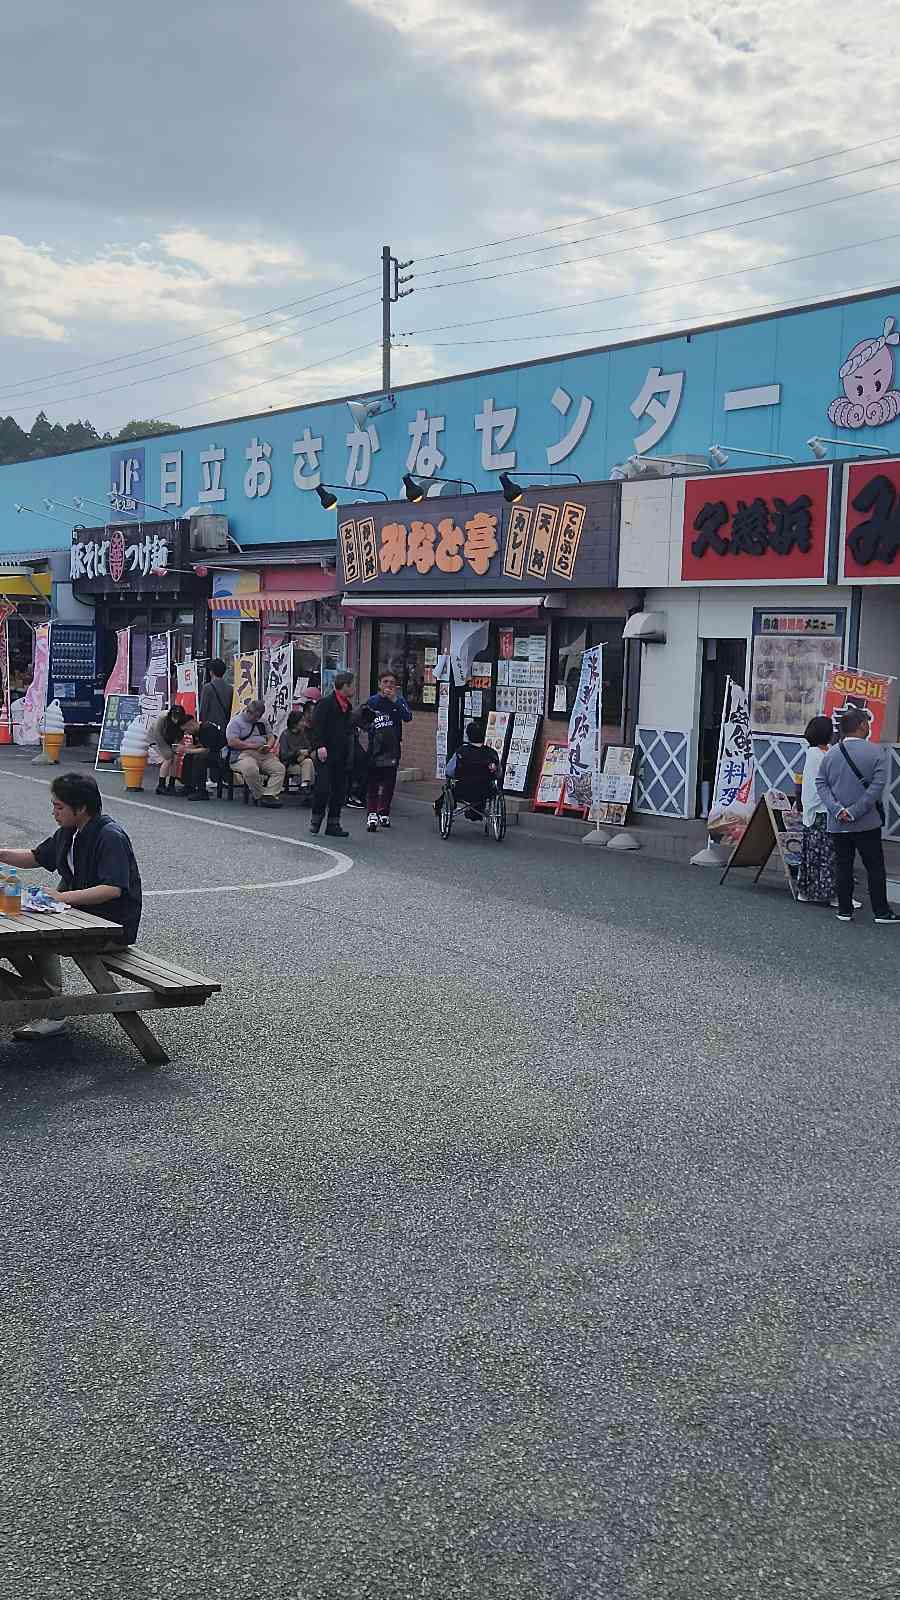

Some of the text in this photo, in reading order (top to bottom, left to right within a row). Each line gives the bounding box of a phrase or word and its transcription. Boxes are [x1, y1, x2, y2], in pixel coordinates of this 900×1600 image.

[161, 367, 781, 508] 日立おさかなセンター
[125, 534, 169, 576] つけ麺
[344, 527, 356, 577] とんかつ
[362, 524, 376, 577] かつ丼
[379, 512, 498, 575] みなと亭
[510, 512, 526, 570] カレー
[531, 512, 553, 570] 天丼
[557, 509, 580, 571] てんぷら
[691, 494, 814, 559] 久慈浜
[833, 673, 883, 698] SUSHI
